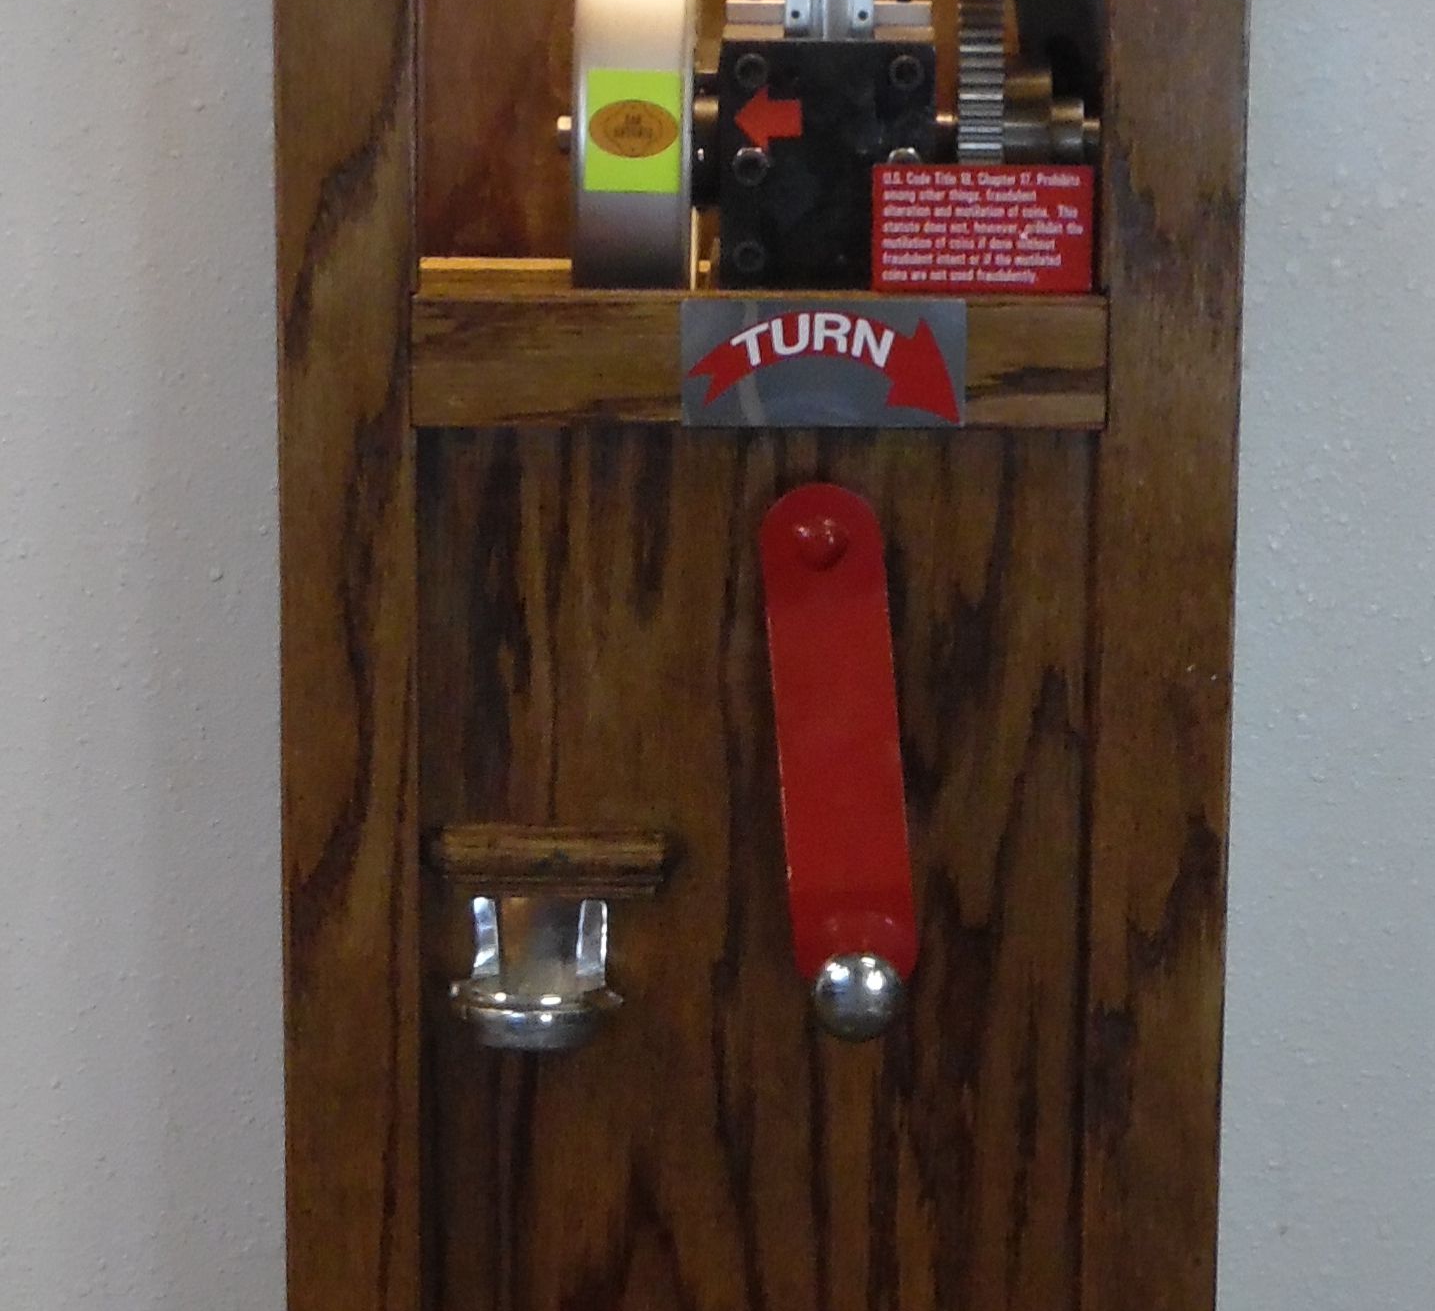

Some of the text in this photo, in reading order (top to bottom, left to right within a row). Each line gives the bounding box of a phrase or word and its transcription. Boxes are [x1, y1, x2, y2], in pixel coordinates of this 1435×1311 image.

[882, 171, 903, 185] U.S.
[906, 171, 930, 185] Code
[935, 171, 956, 185] Title
[977, 171, 1016, 187] Chapter
[1037, 172, 1080, 187] Prohibits
[883, 190, 916, 203] among
[918, 190, 945, 201] other
[986, 190, 1037, 201] fraudulent
[883, 205, 931, 217] alteration
[934, 205, 952, 217] and
[955, 205, 1005, 218] mutilation
[1007, 205, 1018, 218] of
[1057, 204, 1078, 218] This
[883, 222, 920, 234] statute
[923, 222, 947, 234] does
[1066, 222, 1084, 235] the
[882, 238, 1055, 250] mutilation of coins if done without
[882, 252, 1061, 266] fraudulent intent or if the mutilated
[882, 269, 907, 281] coins
[910, 271, 927, 281] are
[929, 269, 946, 281] not
[950, 268, 974, 281] used
[730, 312, 895, 368] TURN
